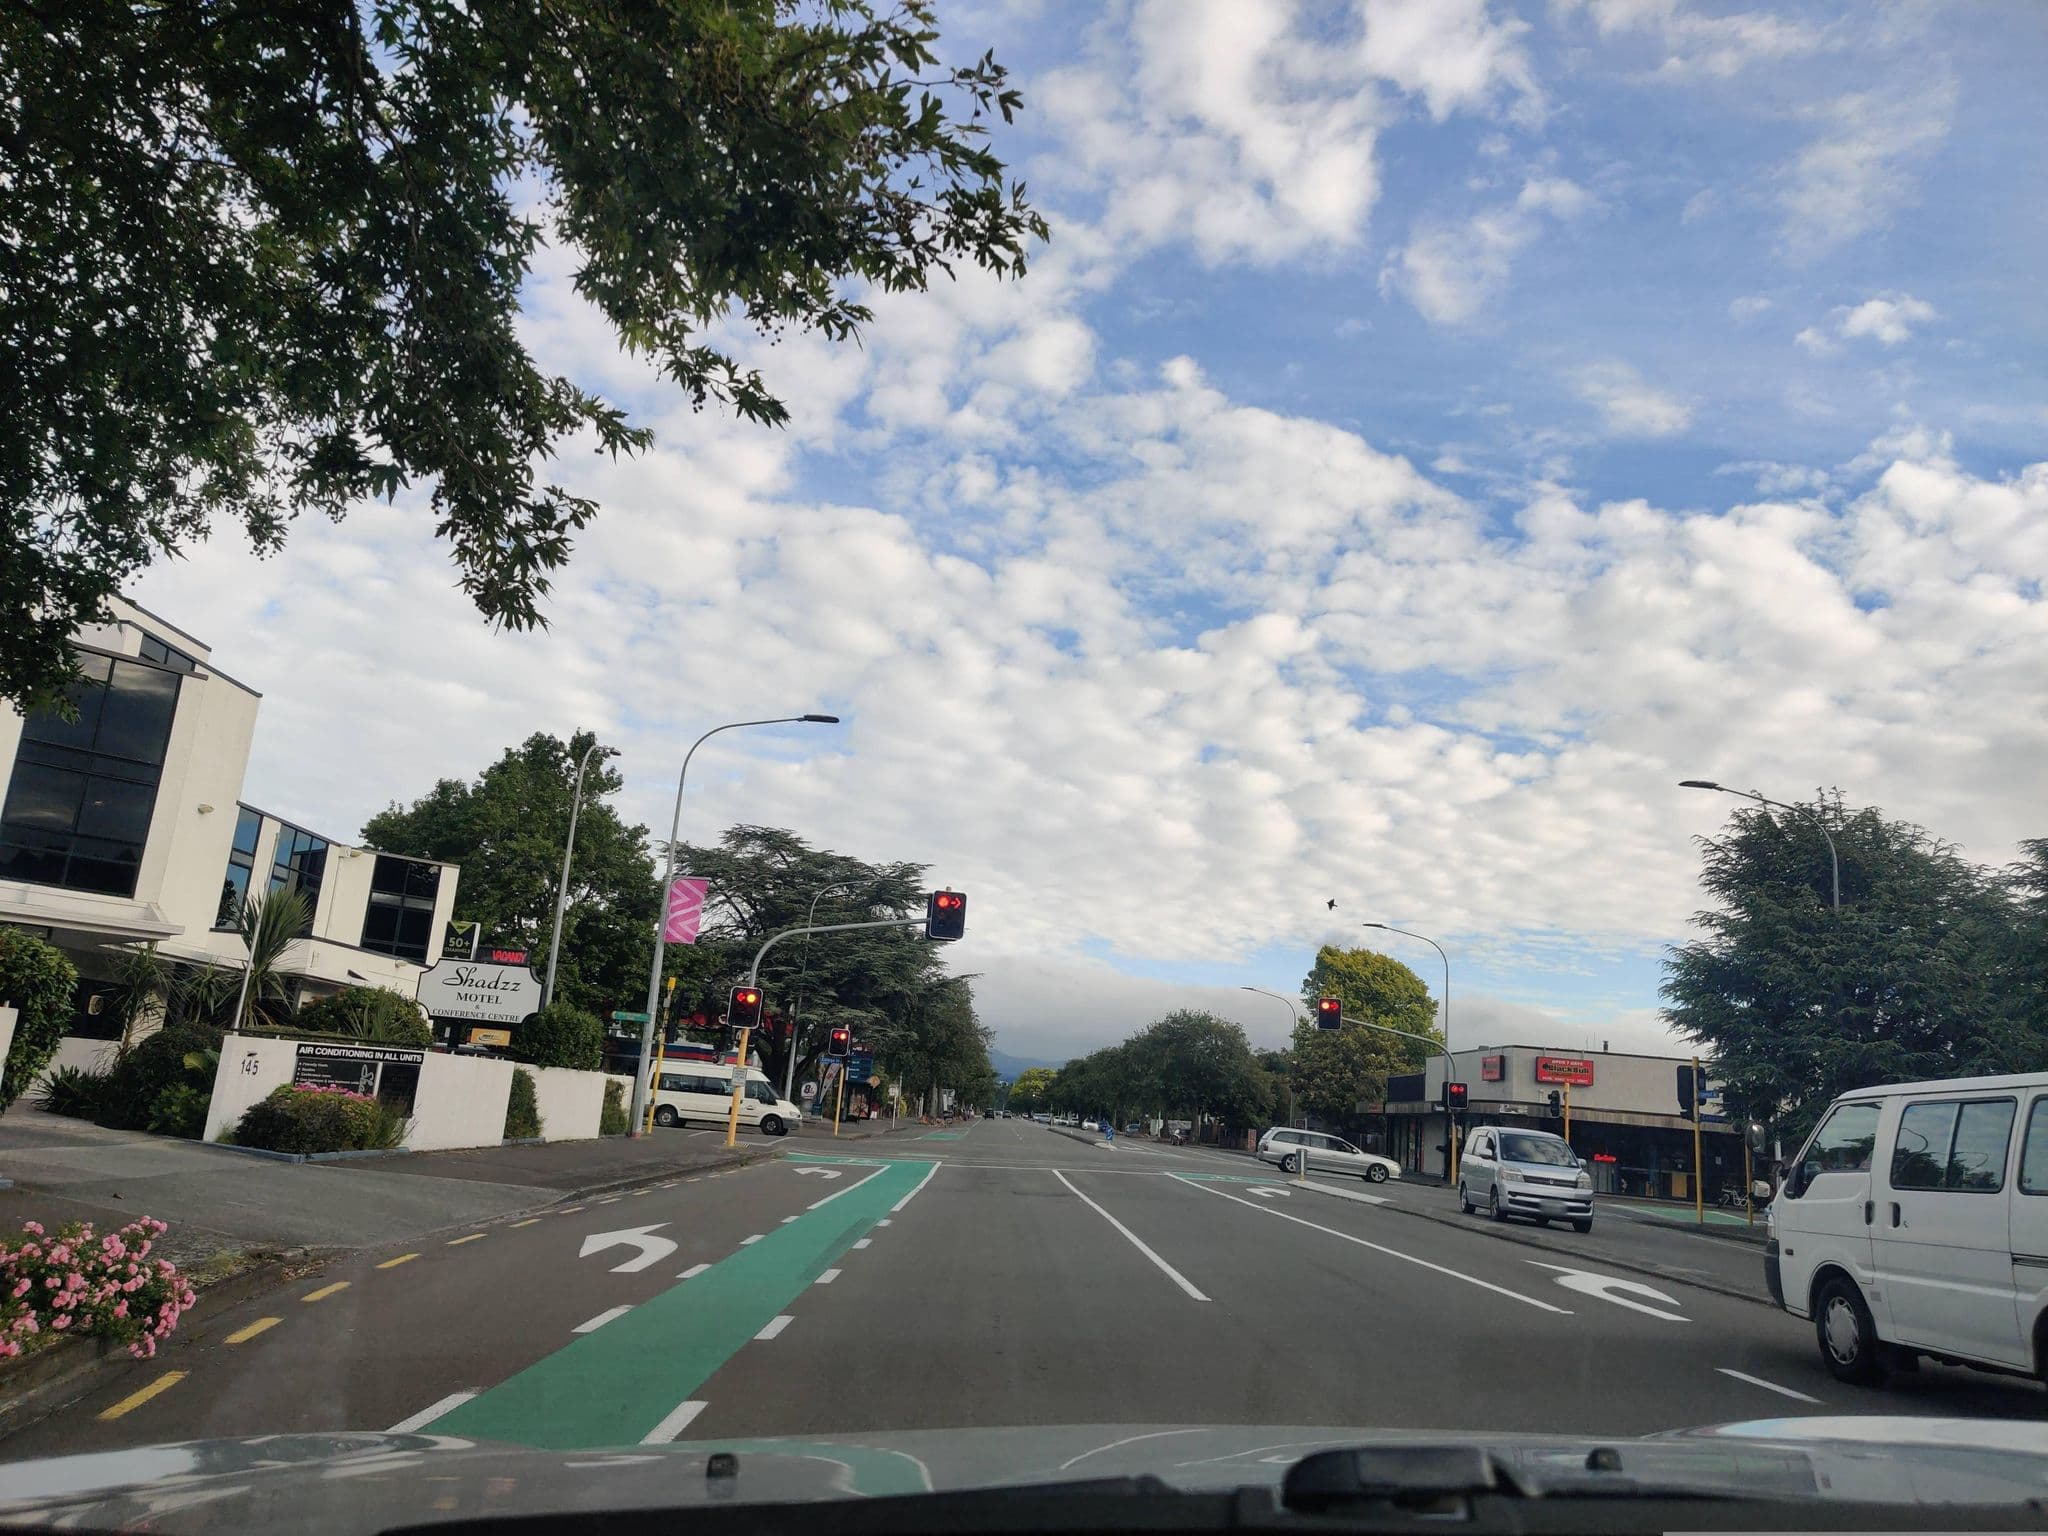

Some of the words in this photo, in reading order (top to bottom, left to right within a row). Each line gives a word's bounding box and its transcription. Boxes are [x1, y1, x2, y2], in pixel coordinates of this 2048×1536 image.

[448, 937, 470, 947] 50+
[492, 950, 526, 963] VACANCY
[442, 966, 521, 991] Shadzz
[456, 992, 502, 1004] MOTEL
[432, 1008, 487, 1019] CONFERENCE
[488, 1012, 520, 1022] CENTRE
[299, 1046, 314, 1055] AIR
[315, 1047, 374, 1059] CONDITIONING
[384, 1052, 399, 1060] ALL
[400, 1053, 422, 1062] UNITS
[241, 1059, 259, 1075] 145
